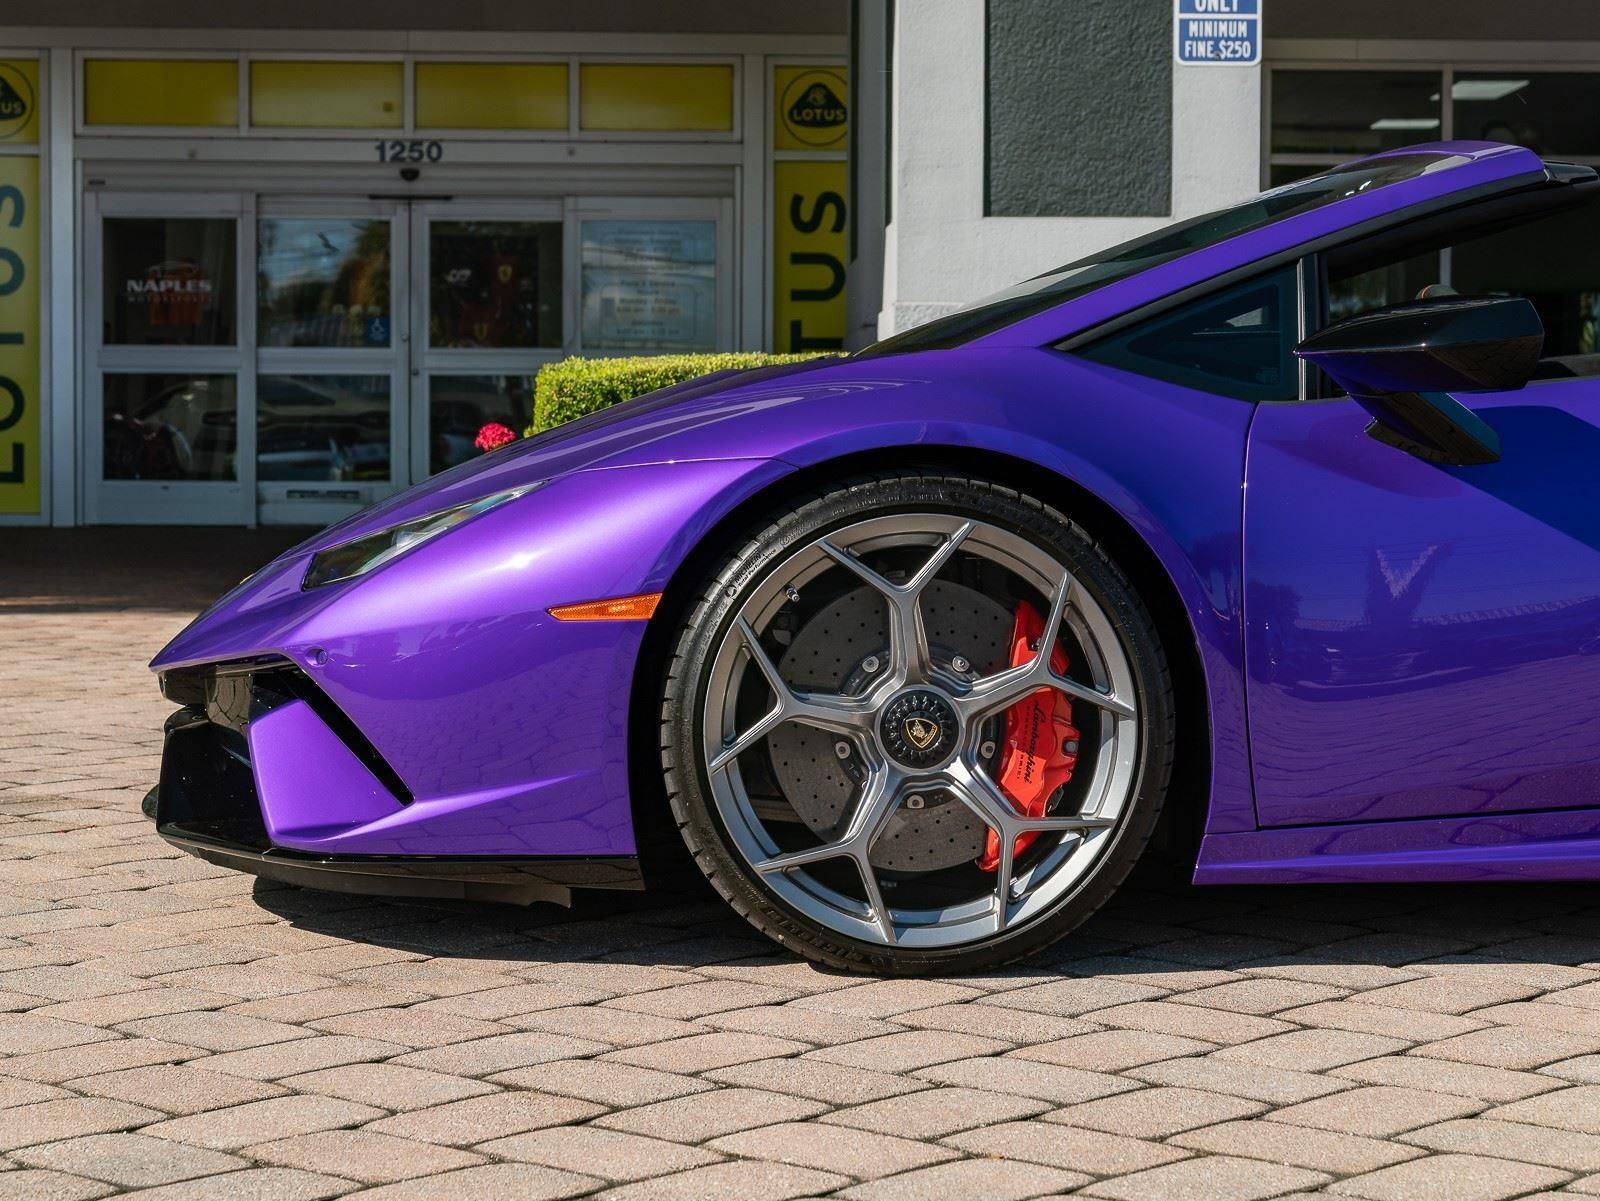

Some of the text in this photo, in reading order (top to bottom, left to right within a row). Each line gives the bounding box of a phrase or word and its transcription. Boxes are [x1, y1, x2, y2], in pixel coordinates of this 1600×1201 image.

[1188, 20, 1248, 38] MINIMUM
[1184, 39, 1251, 60] FINE $250
[793, 108, 845, 121] LOTUS
[374, 140, 443, 162] 1250
[126, 278, 212, 292] NAPLES
